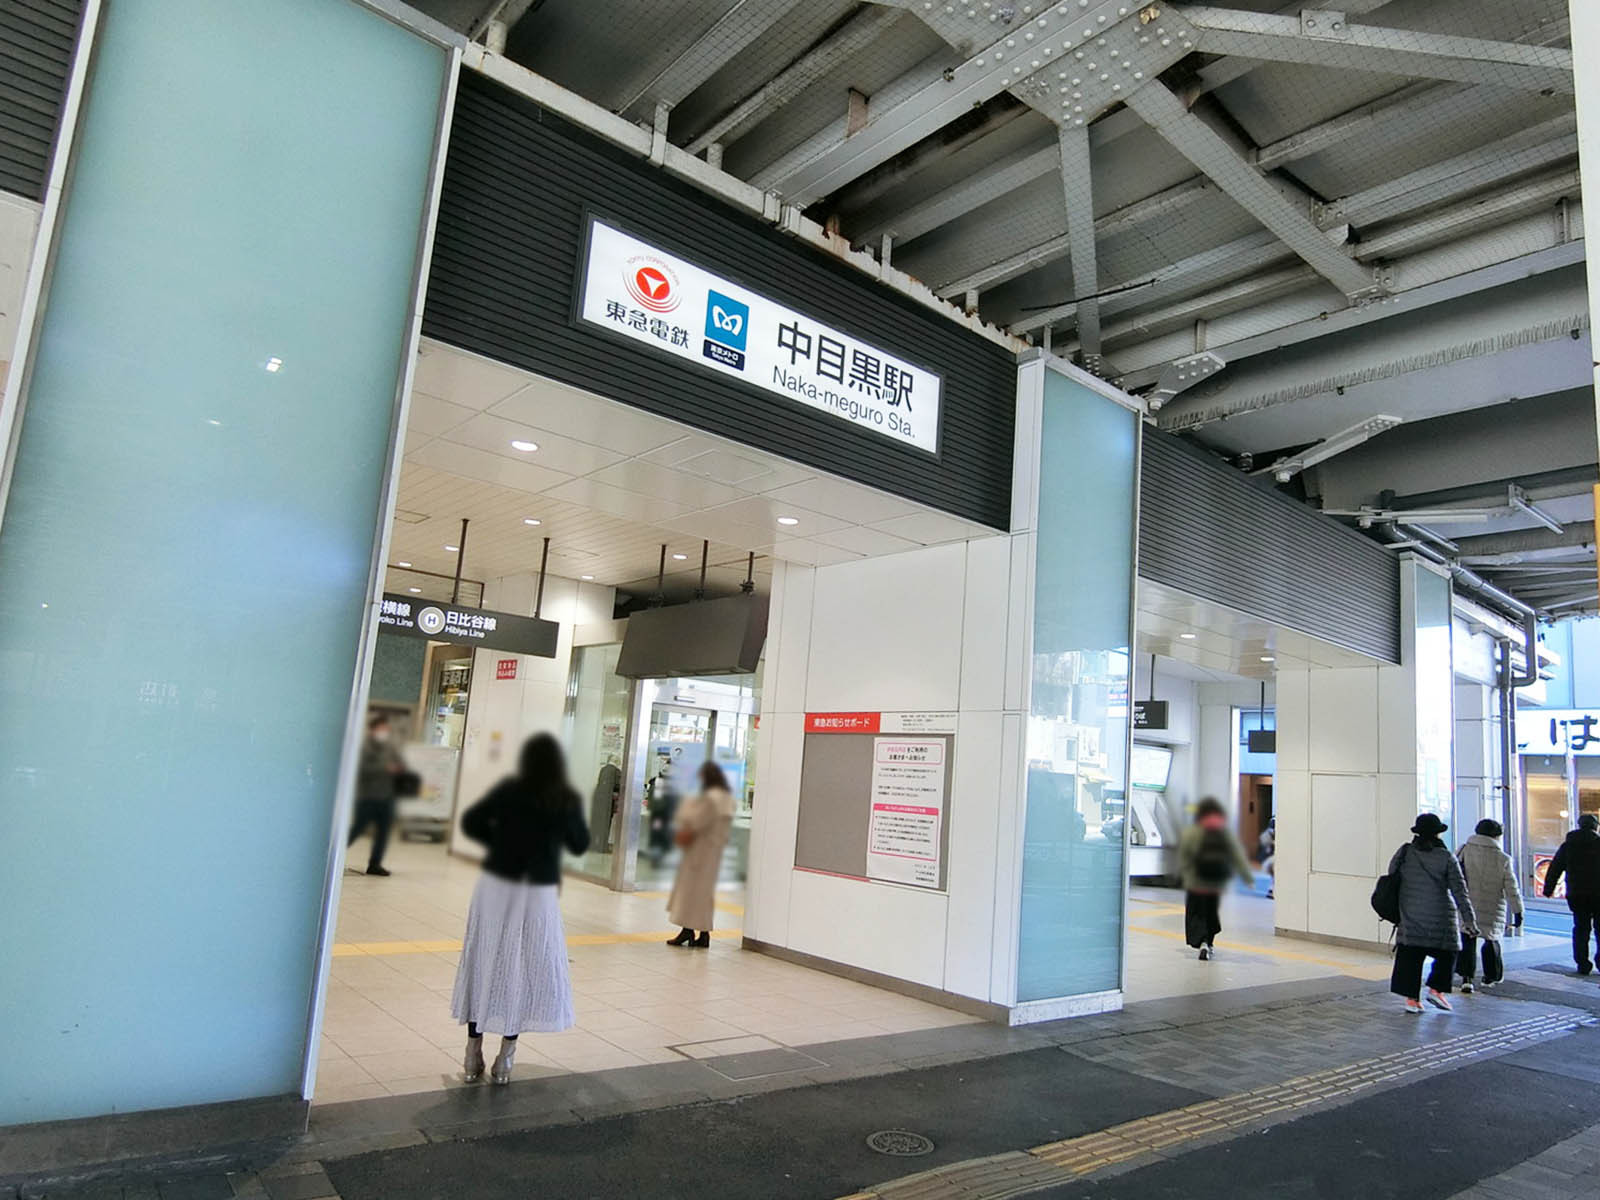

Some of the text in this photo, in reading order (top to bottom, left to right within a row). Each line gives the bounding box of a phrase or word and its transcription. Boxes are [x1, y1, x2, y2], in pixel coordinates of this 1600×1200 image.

[605, 298, 690, 350] 東急電鉄
[776, 321, 914, 413] 中目黒駅
[772, 365, 916, 439] Naka-meguro Sta.
[380, 599, 411, 617] 横線
[396, 617, 414, 628] Line
[427, 616, 436, 625] H
[446, 611, 497, 631] 日比谷線
[445, 625, 486, 639] Hibiya Line
